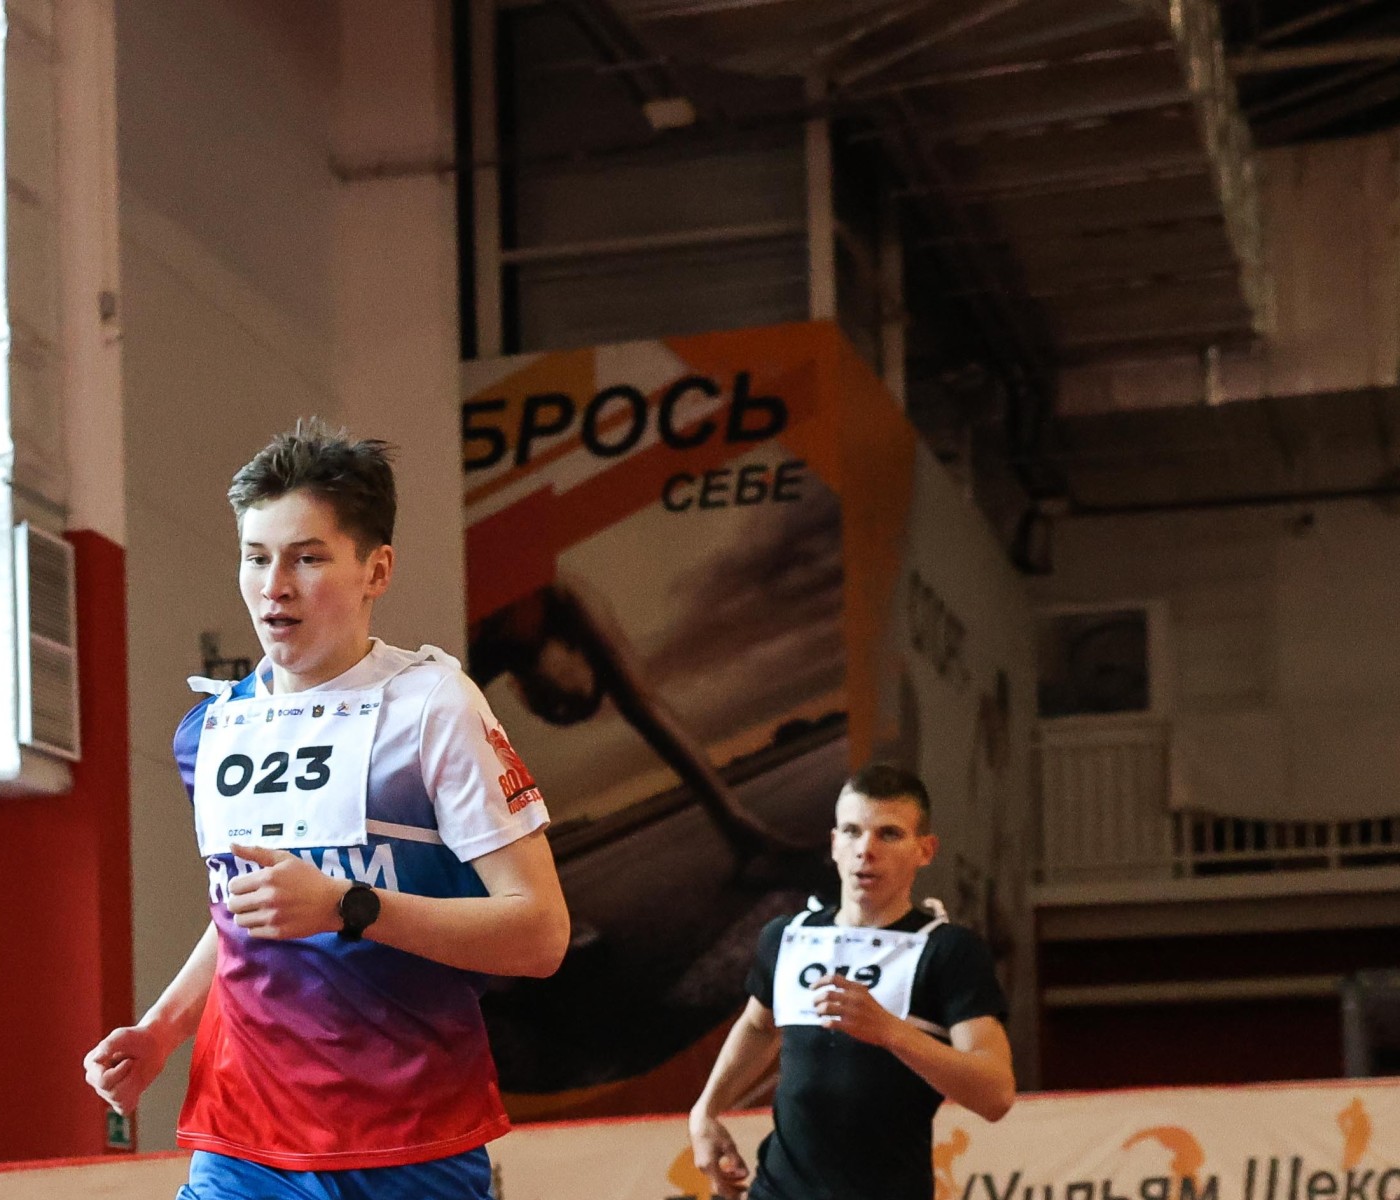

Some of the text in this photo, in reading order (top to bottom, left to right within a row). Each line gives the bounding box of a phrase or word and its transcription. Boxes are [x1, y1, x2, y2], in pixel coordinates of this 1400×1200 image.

[462, 371, 789, 471] БРОСЬ
[661, 460, 808, 512] СЕБЕ
[215, 745, 333, 798] 023
[508, 789, 542, 815] ПОБЕД
